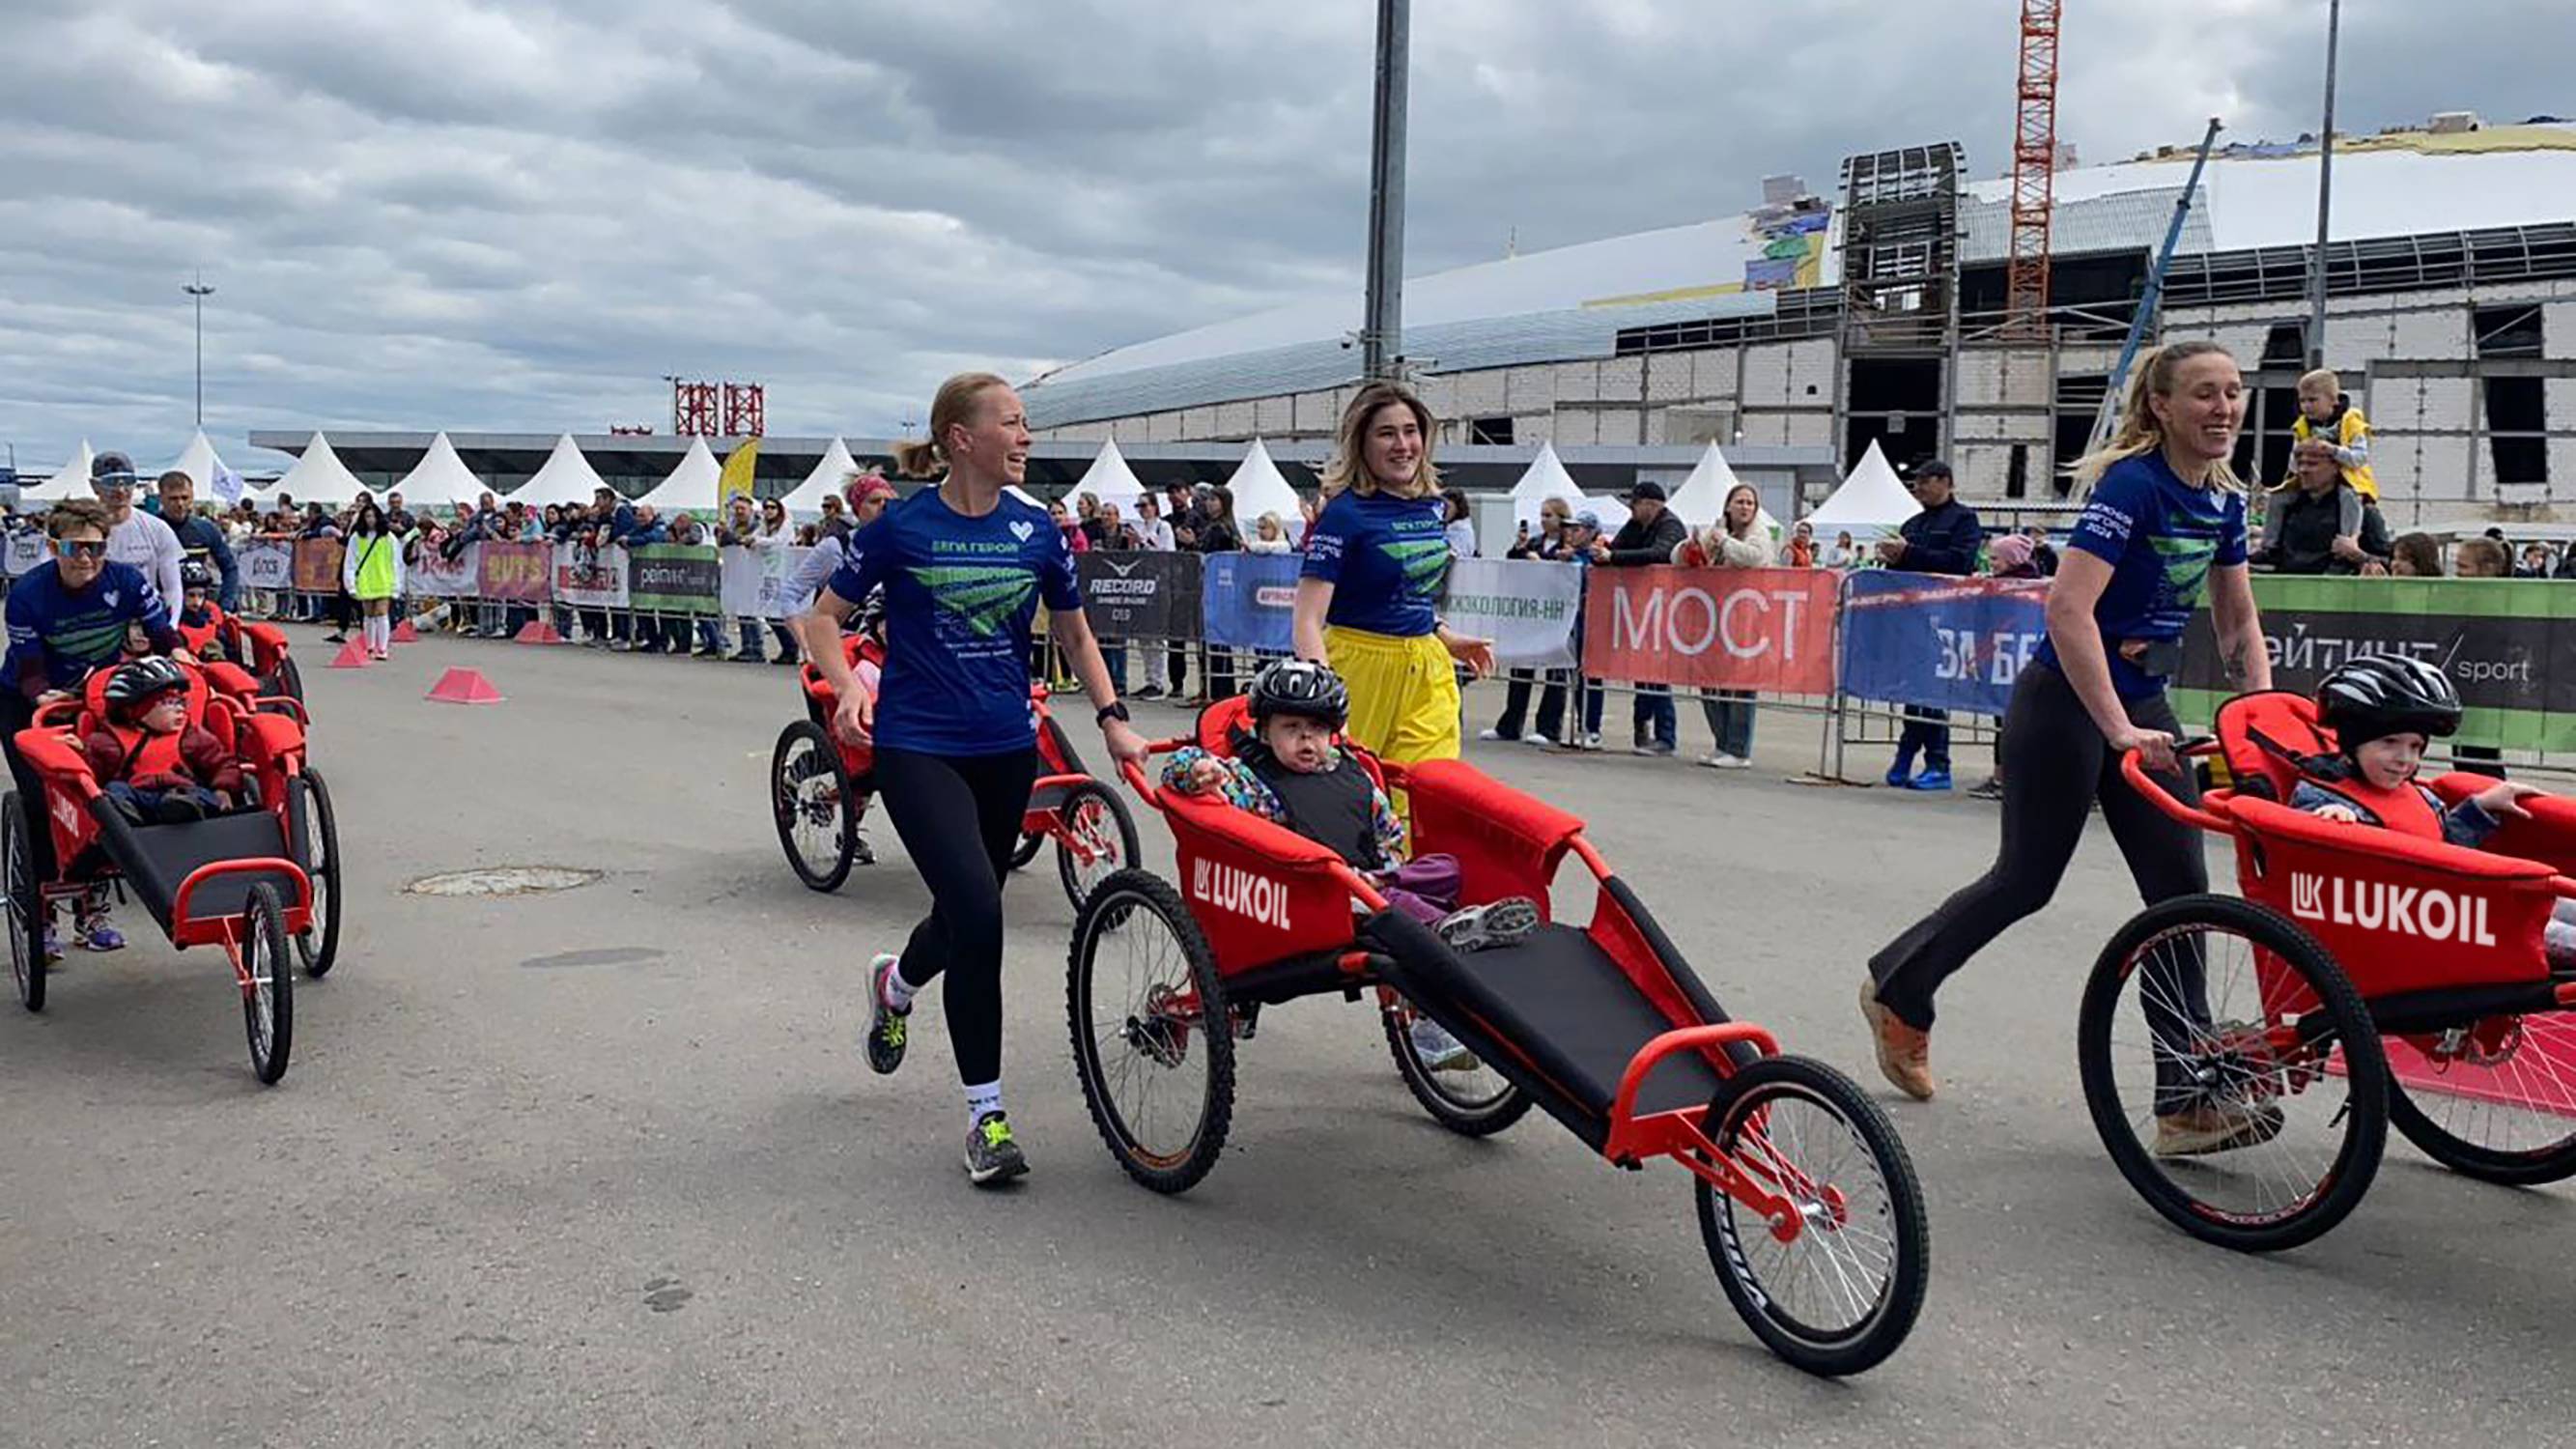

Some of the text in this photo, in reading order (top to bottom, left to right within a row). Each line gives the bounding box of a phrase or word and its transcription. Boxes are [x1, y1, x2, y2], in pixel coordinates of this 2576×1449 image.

[1090, 579, 1156, 594] RECORD
[1613, 585, 1808, 661] МОСТ
[1935, 629, 2045, 686] ЗА БЕ
[1213, 863, 1291, 931] LUKOIL
[2333, 876, 2497, 948] LUKOIL
